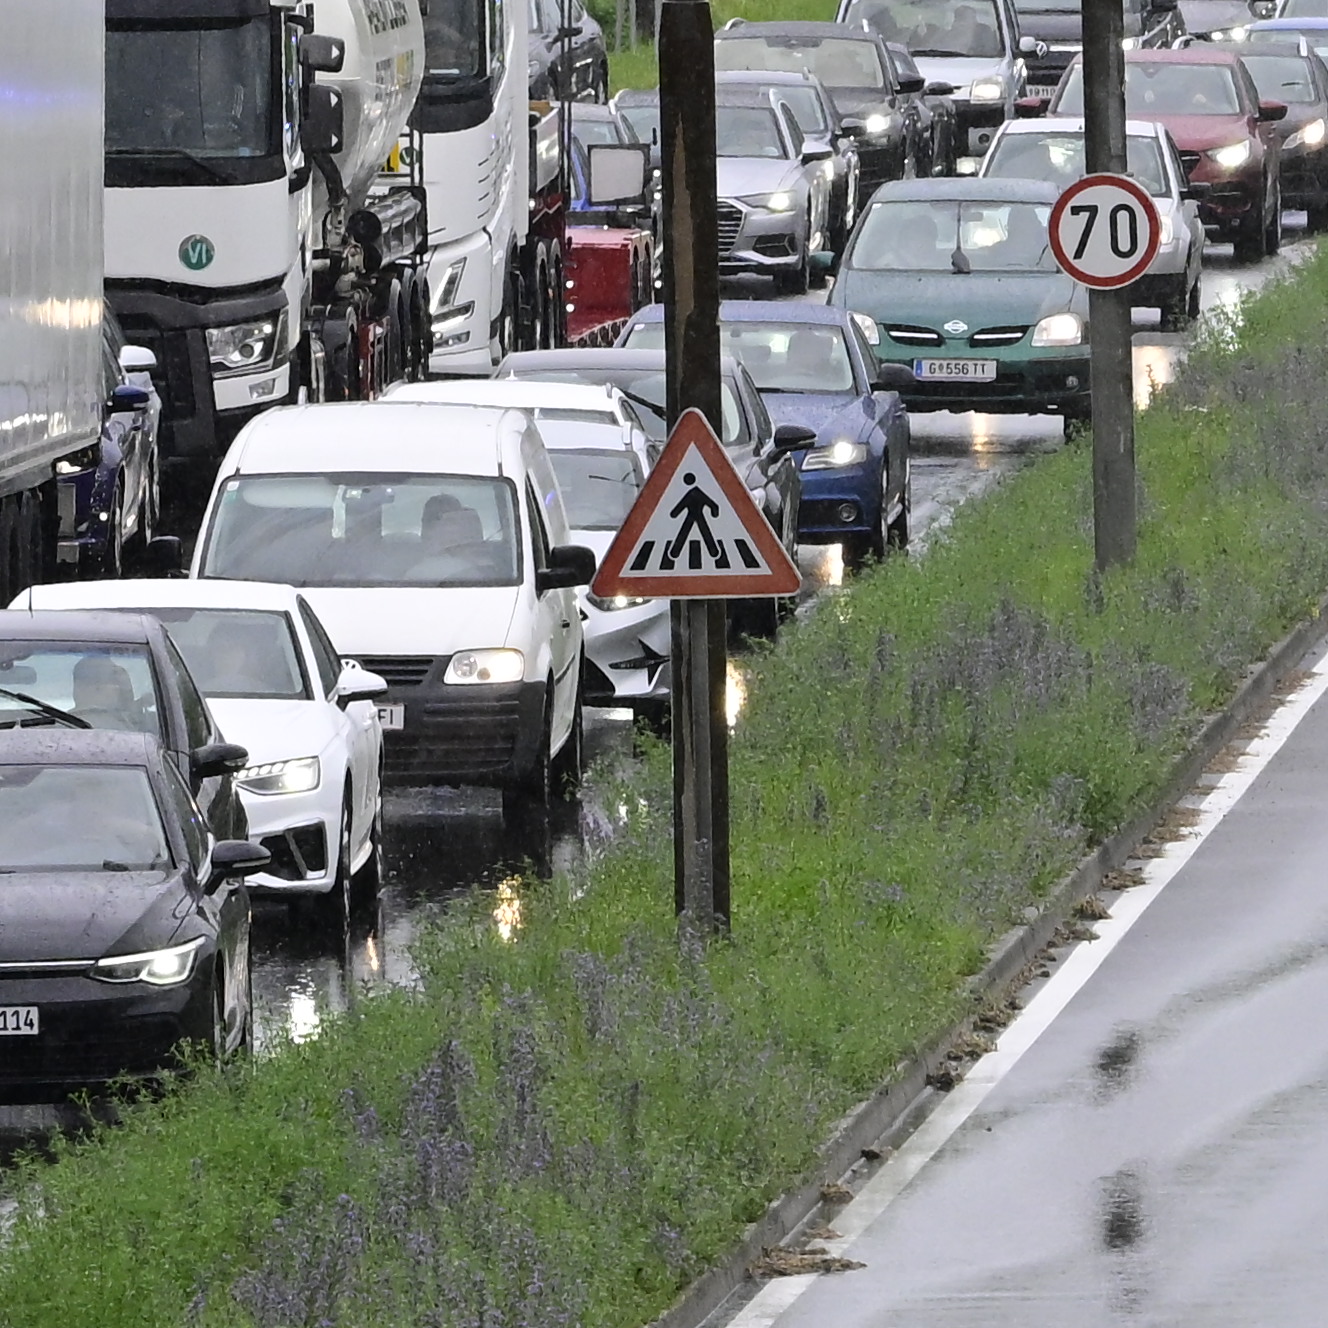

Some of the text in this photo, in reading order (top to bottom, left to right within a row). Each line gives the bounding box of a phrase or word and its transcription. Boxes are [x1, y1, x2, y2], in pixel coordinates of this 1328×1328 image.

[1070, 203, 1138, 260] 70
[188, 239, 207, 265] VI
[928, 362, 937, 375] G
[945, 362, 969, 375] 556
